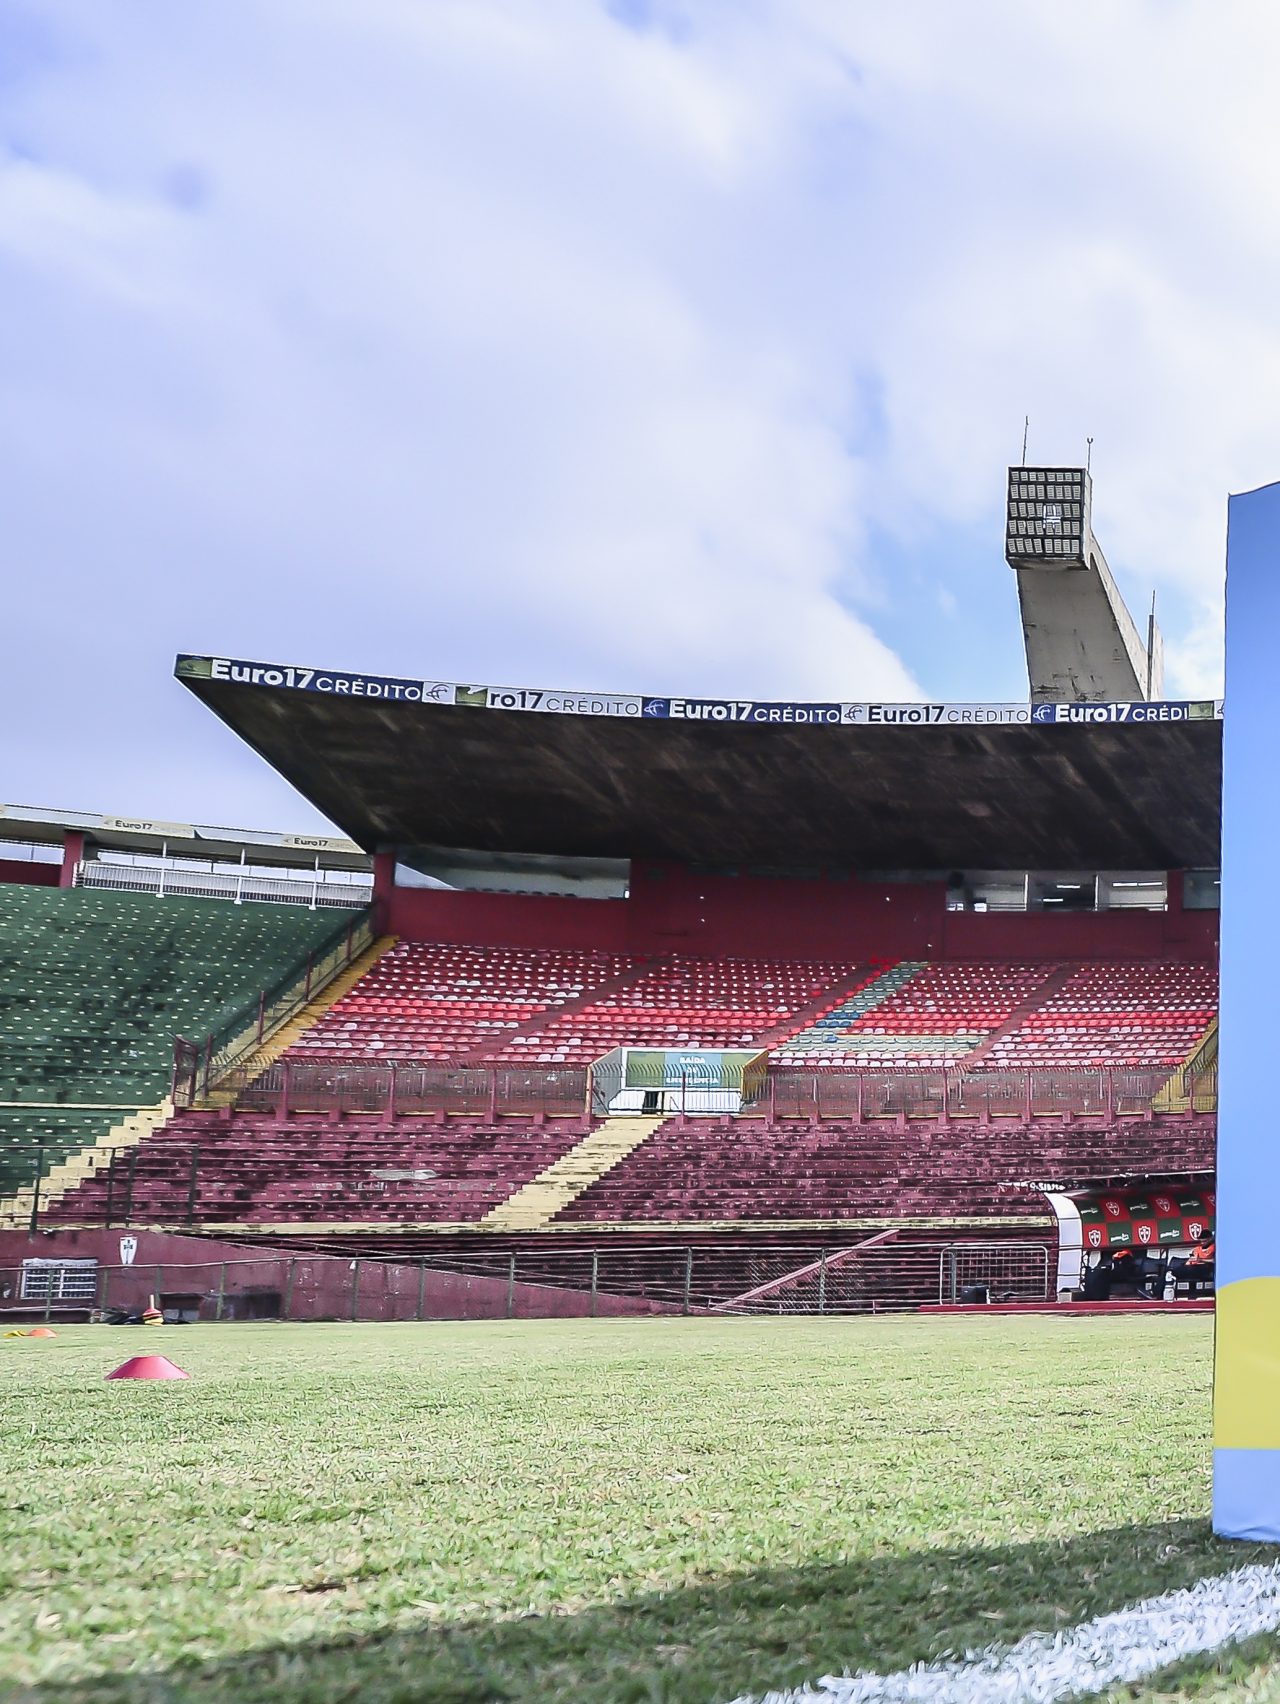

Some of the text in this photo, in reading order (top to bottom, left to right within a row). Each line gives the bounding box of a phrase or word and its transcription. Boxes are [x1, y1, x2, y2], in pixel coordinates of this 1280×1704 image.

[210, 658, 421, 701] Euro17 CRÉDITO
[487, 690, 640, 716] ro17 CRÉDITO
[669, 700, 840, 724] Euro17 CRÉDITO
[1055, 703, 1189, 722] Euro17 CRÉDI
[868, 705, 1029, 724] Euro17 CRÉDITO
[115, 820, 153, 831] Euro17
[294, 837, 329, 847] Euro17
